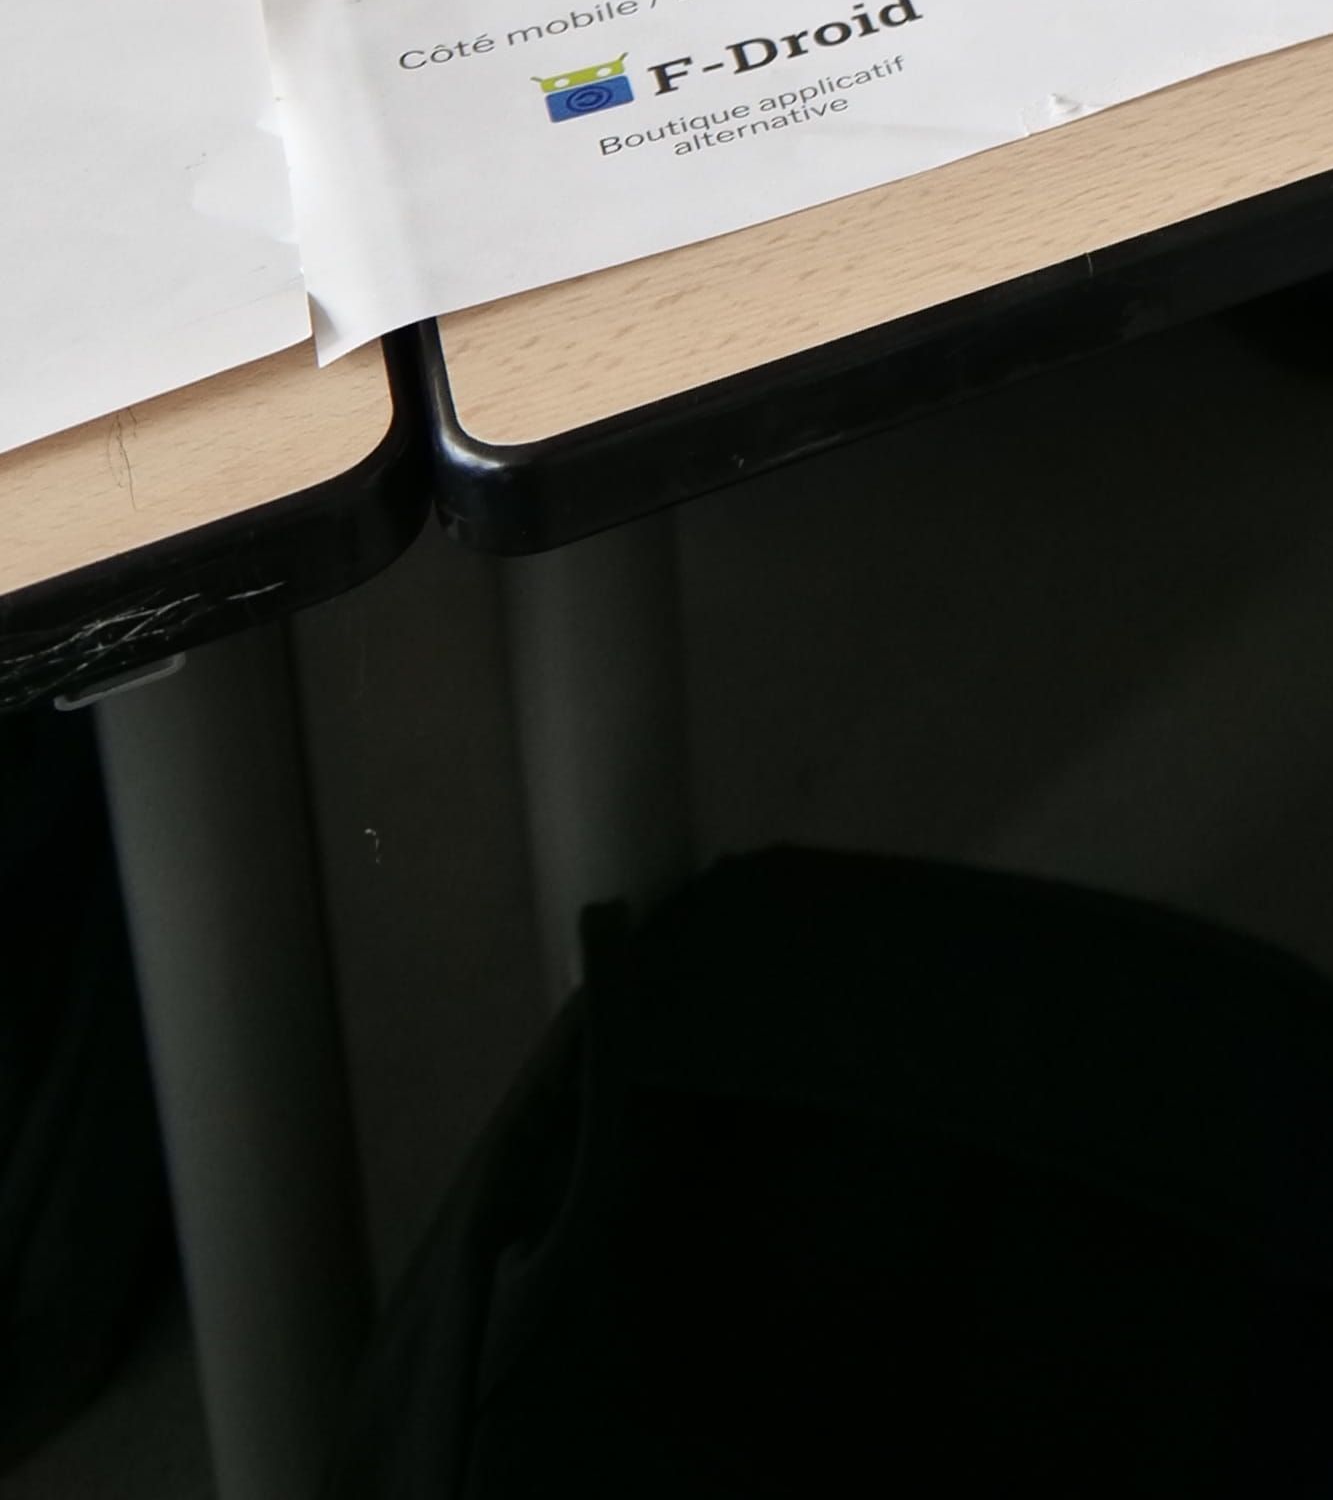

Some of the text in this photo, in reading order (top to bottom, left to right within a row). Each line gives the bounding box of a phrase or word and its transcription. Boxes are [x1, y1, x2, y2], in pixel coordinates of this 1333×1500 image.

[398, 33, 495, 70] Côté
[506, 0, 639, 46] mobile
[599, 54, 907, 157] Boutique applicatif
[673, 97, 850, 156] alternative
